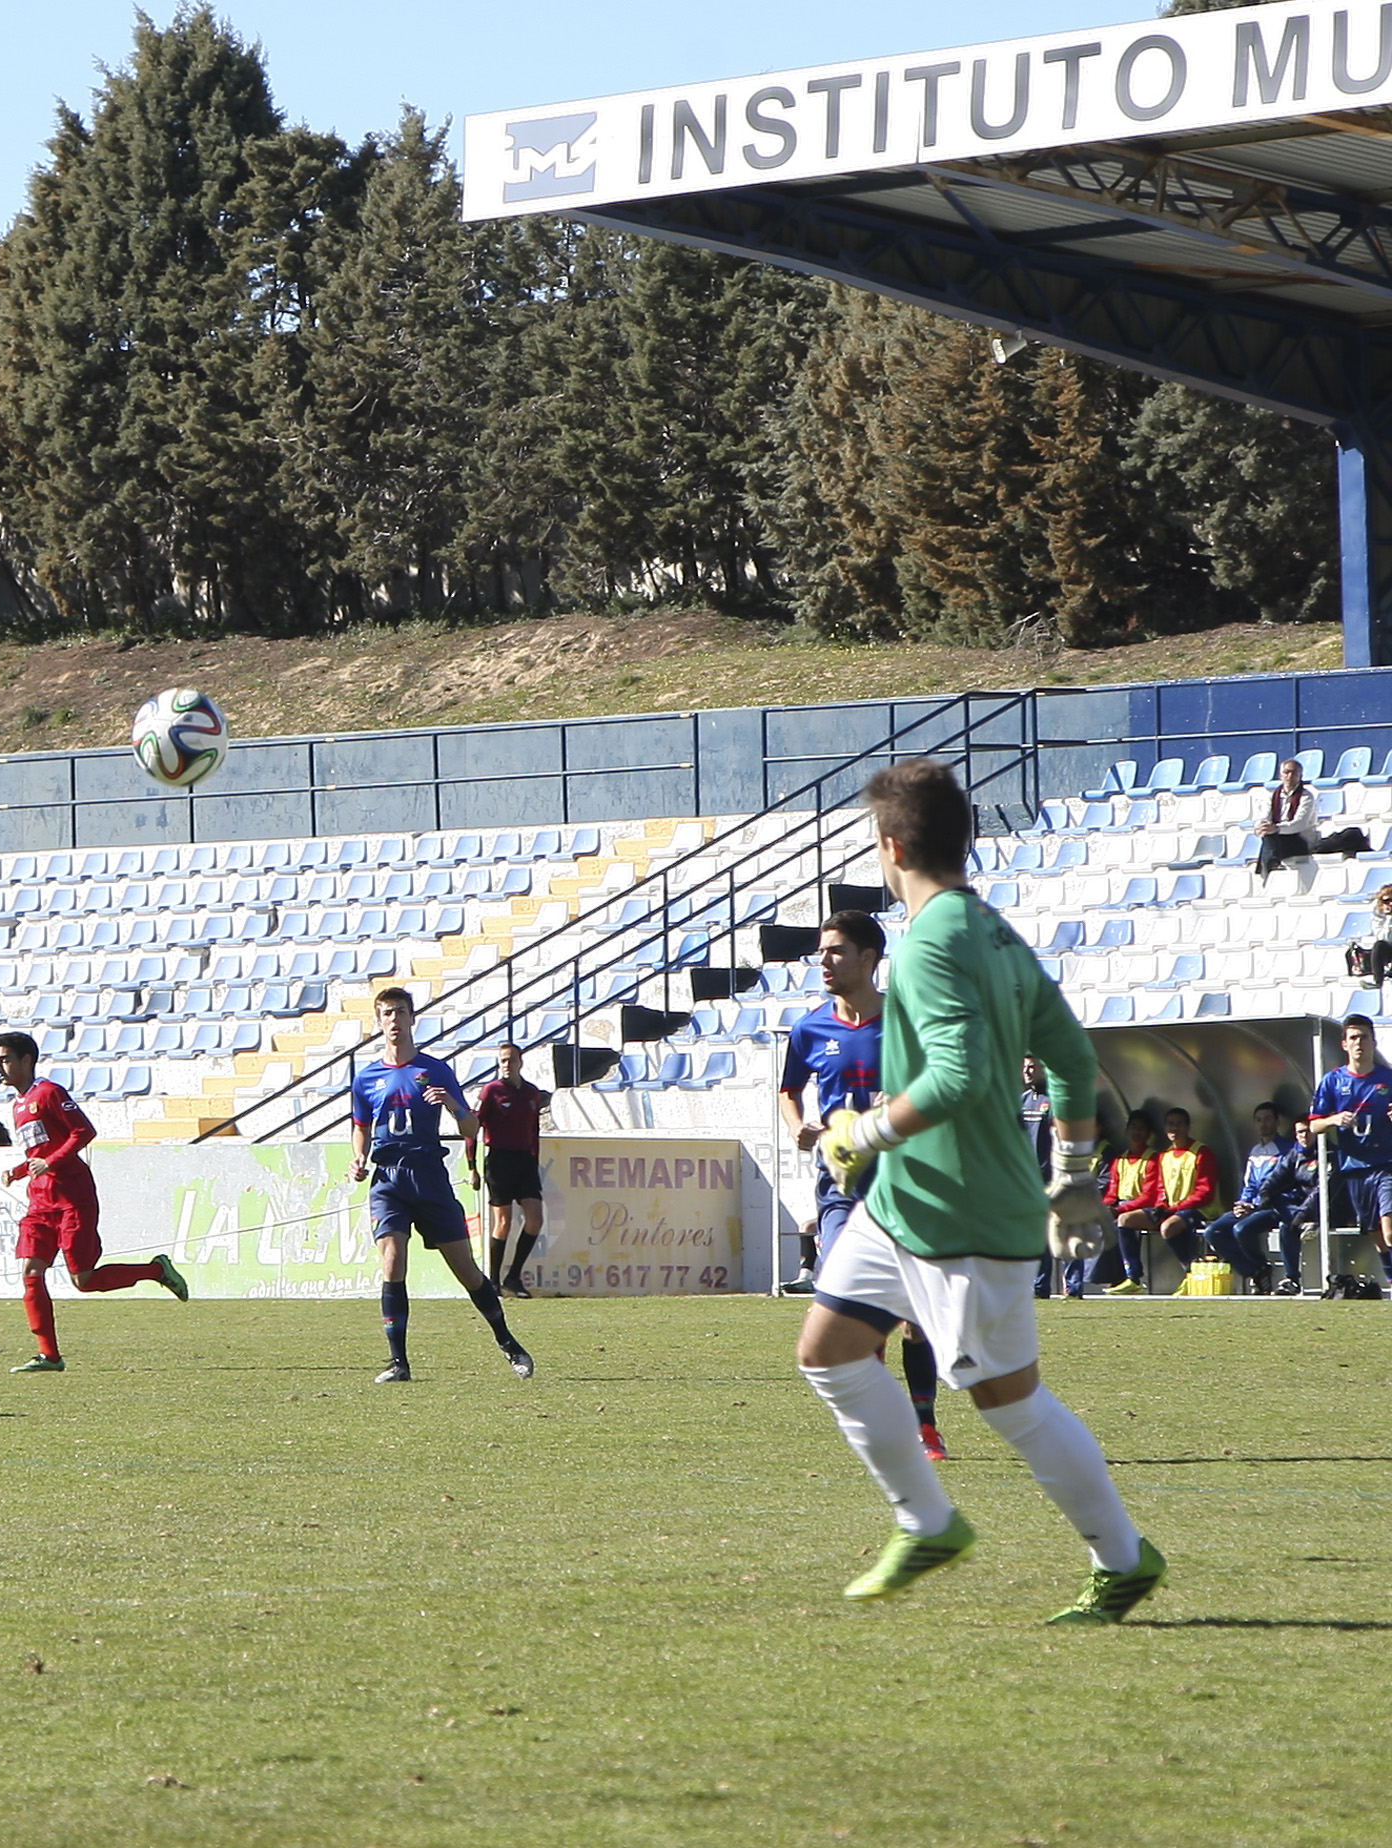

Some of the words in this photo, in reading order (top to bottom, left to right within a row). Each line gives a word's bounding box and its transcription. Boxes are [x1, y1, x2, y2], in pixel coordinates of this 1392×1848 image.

[637, 34, 1188, 186] INSTITUTO
[1232, 3, 1392, 109] MU
[569, 1156, 735, 1190] REMAPIN
[587, 1199, 717, 1248] Pintores
[567, 1265, 598, 1287] 91
[605, 1265, 652, 1288] 617
[659, 1265, 691, 1288] 77
[698, 1265, 730, 1288] 42
